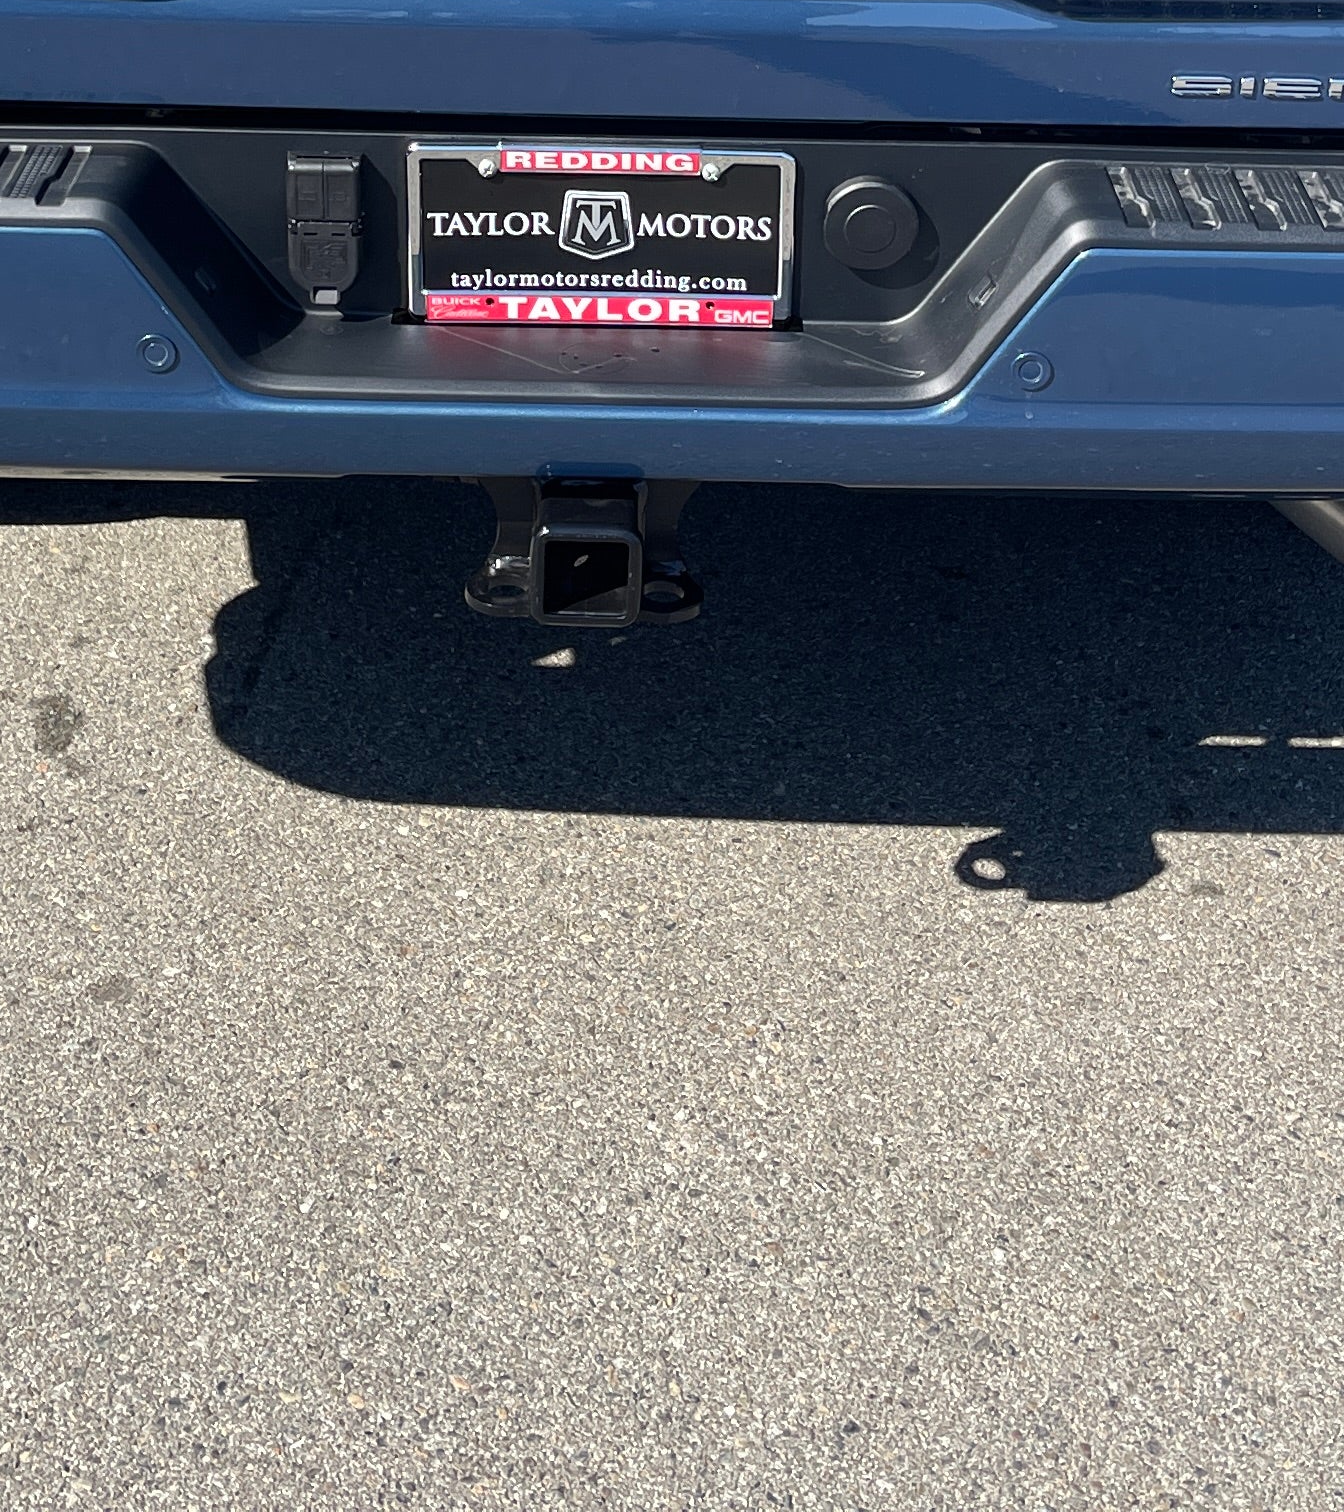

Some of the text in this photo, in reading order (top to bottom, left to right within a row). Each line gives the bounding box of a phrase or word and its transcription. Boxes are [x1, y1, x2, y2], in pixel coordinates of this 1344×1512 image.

[505, 152, 694, 172] REDDING
[426, 211, 772, 241] TAYLOR MOTORS
[450, 268, 748, 293] taylormotorsredding.com
[431, 297, 481, 306] BUICK
[498, 296, 702, 322] TAYLOR
[714, 308, 771, 325] GMC
